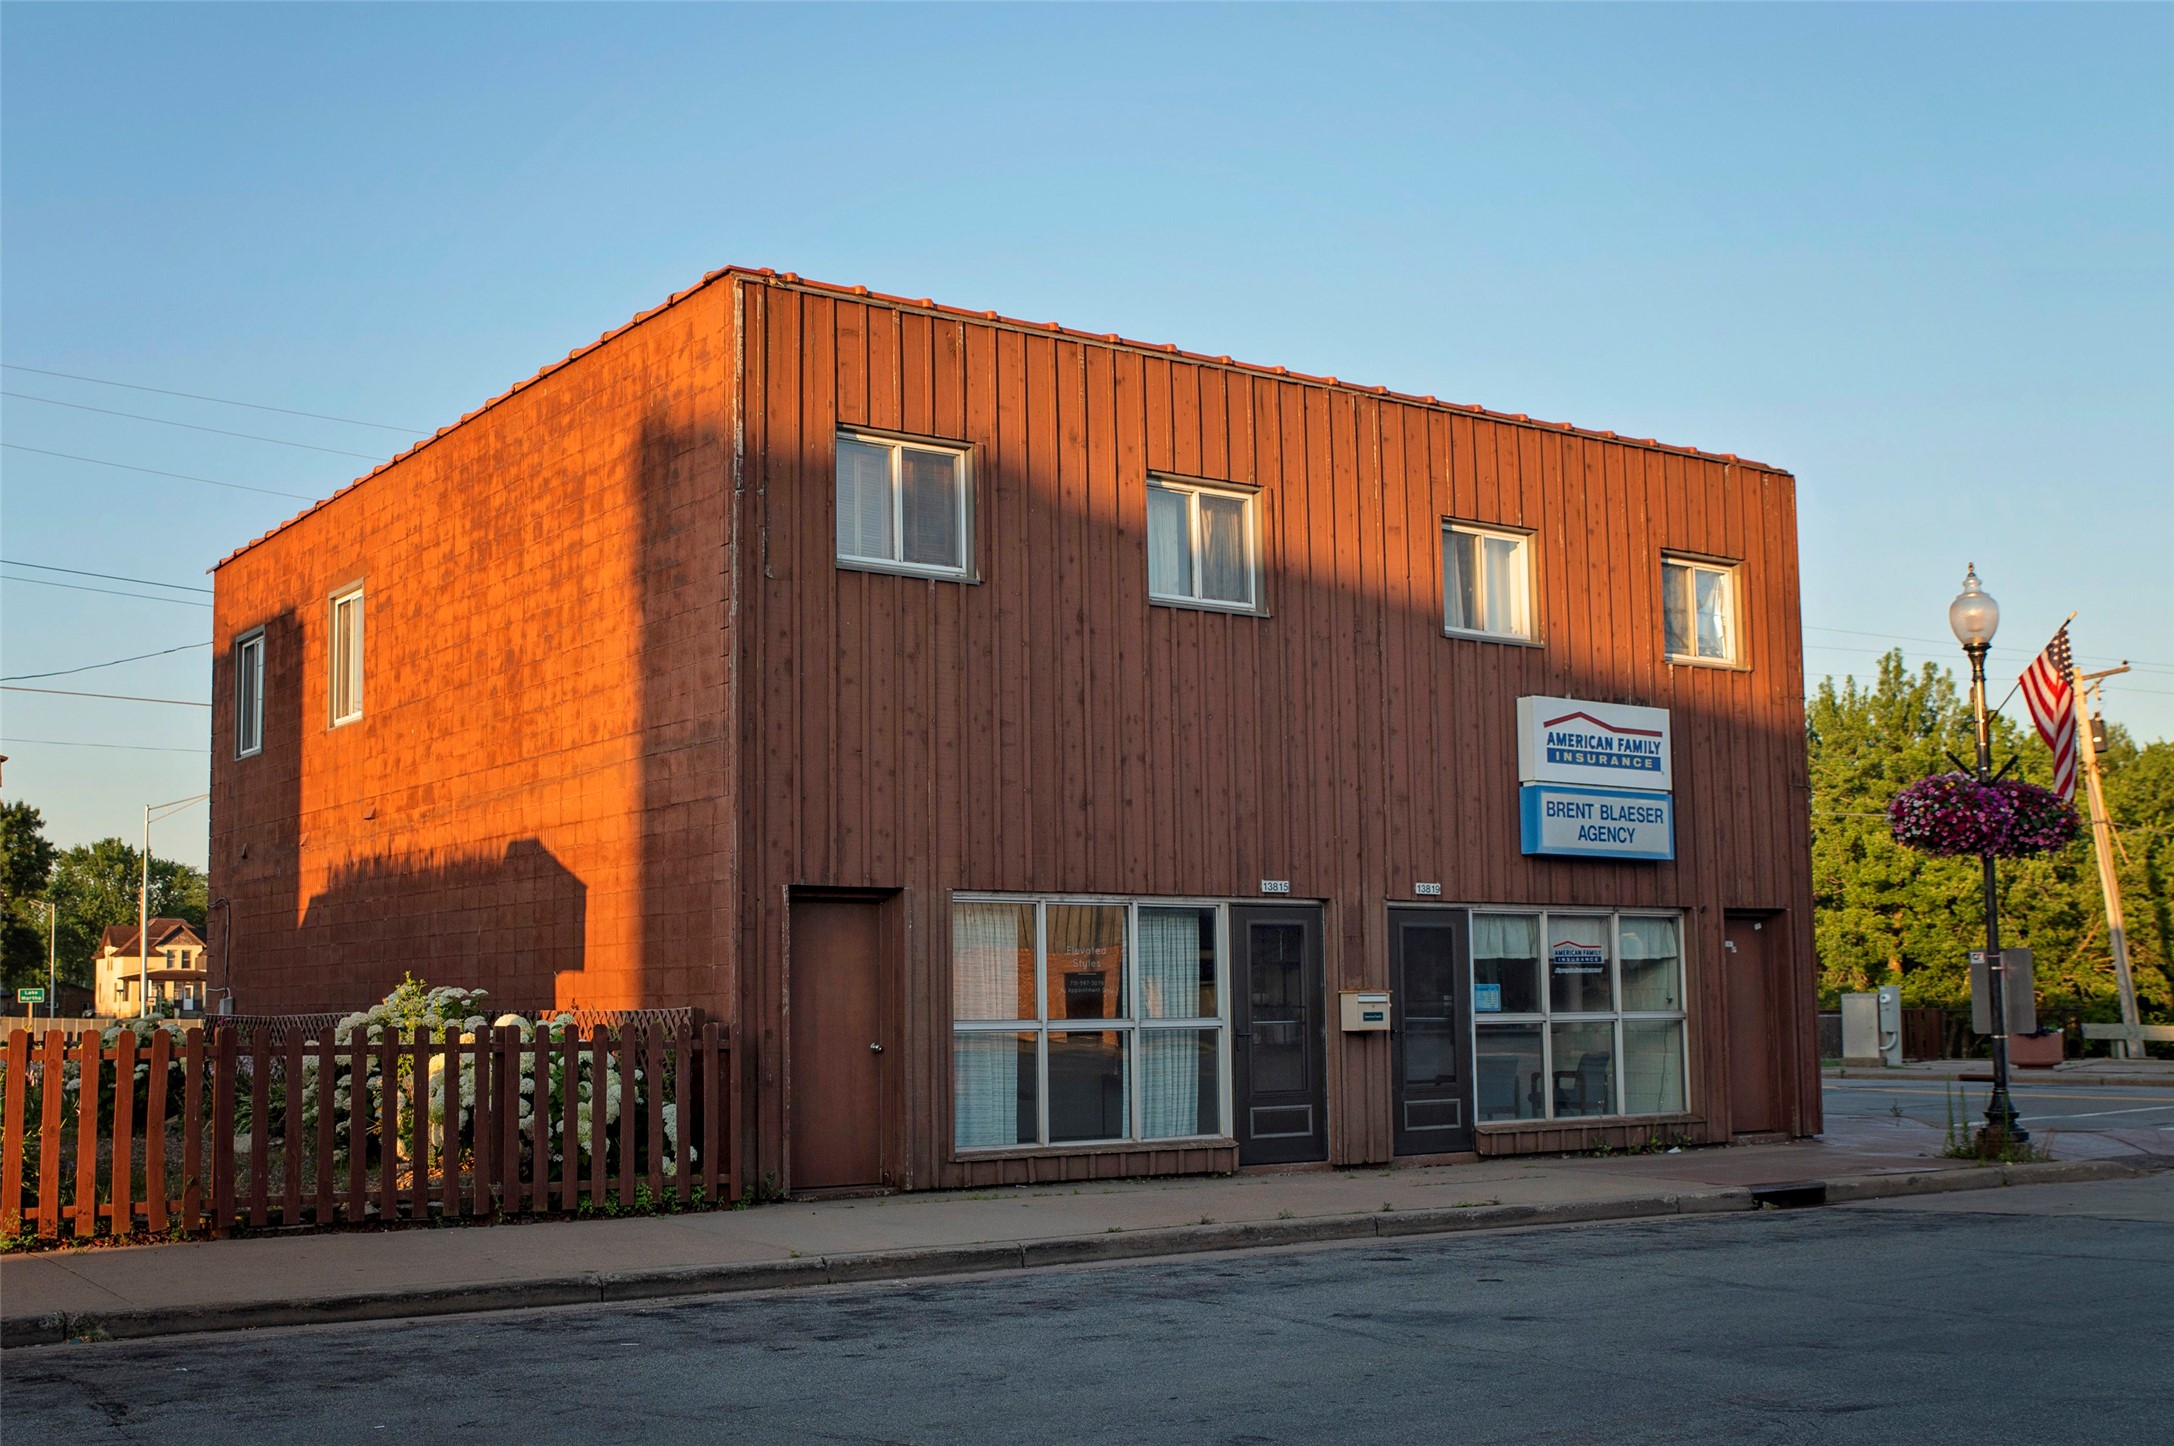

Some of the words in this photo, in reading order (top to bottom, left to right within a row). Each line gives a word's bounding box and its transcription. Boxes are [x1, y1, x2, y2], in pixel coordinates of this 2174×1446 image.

[1547, 732, 1613, 751] AMERICAN
[1617, 738, 1661, 755] FAMILY
[1556, 751, 1653, 768] INSURANCE
[1546, 801, 1594, 819] BRENT
[1600, 804, 1664, 824] BLAESER
[1578, 825, 1635, 843] AGENCY
[1263, 881, 1288, 892] 13815
[1417, 883, 1440, 894] 13819
[1072, 959, 1101, 969] Styles
